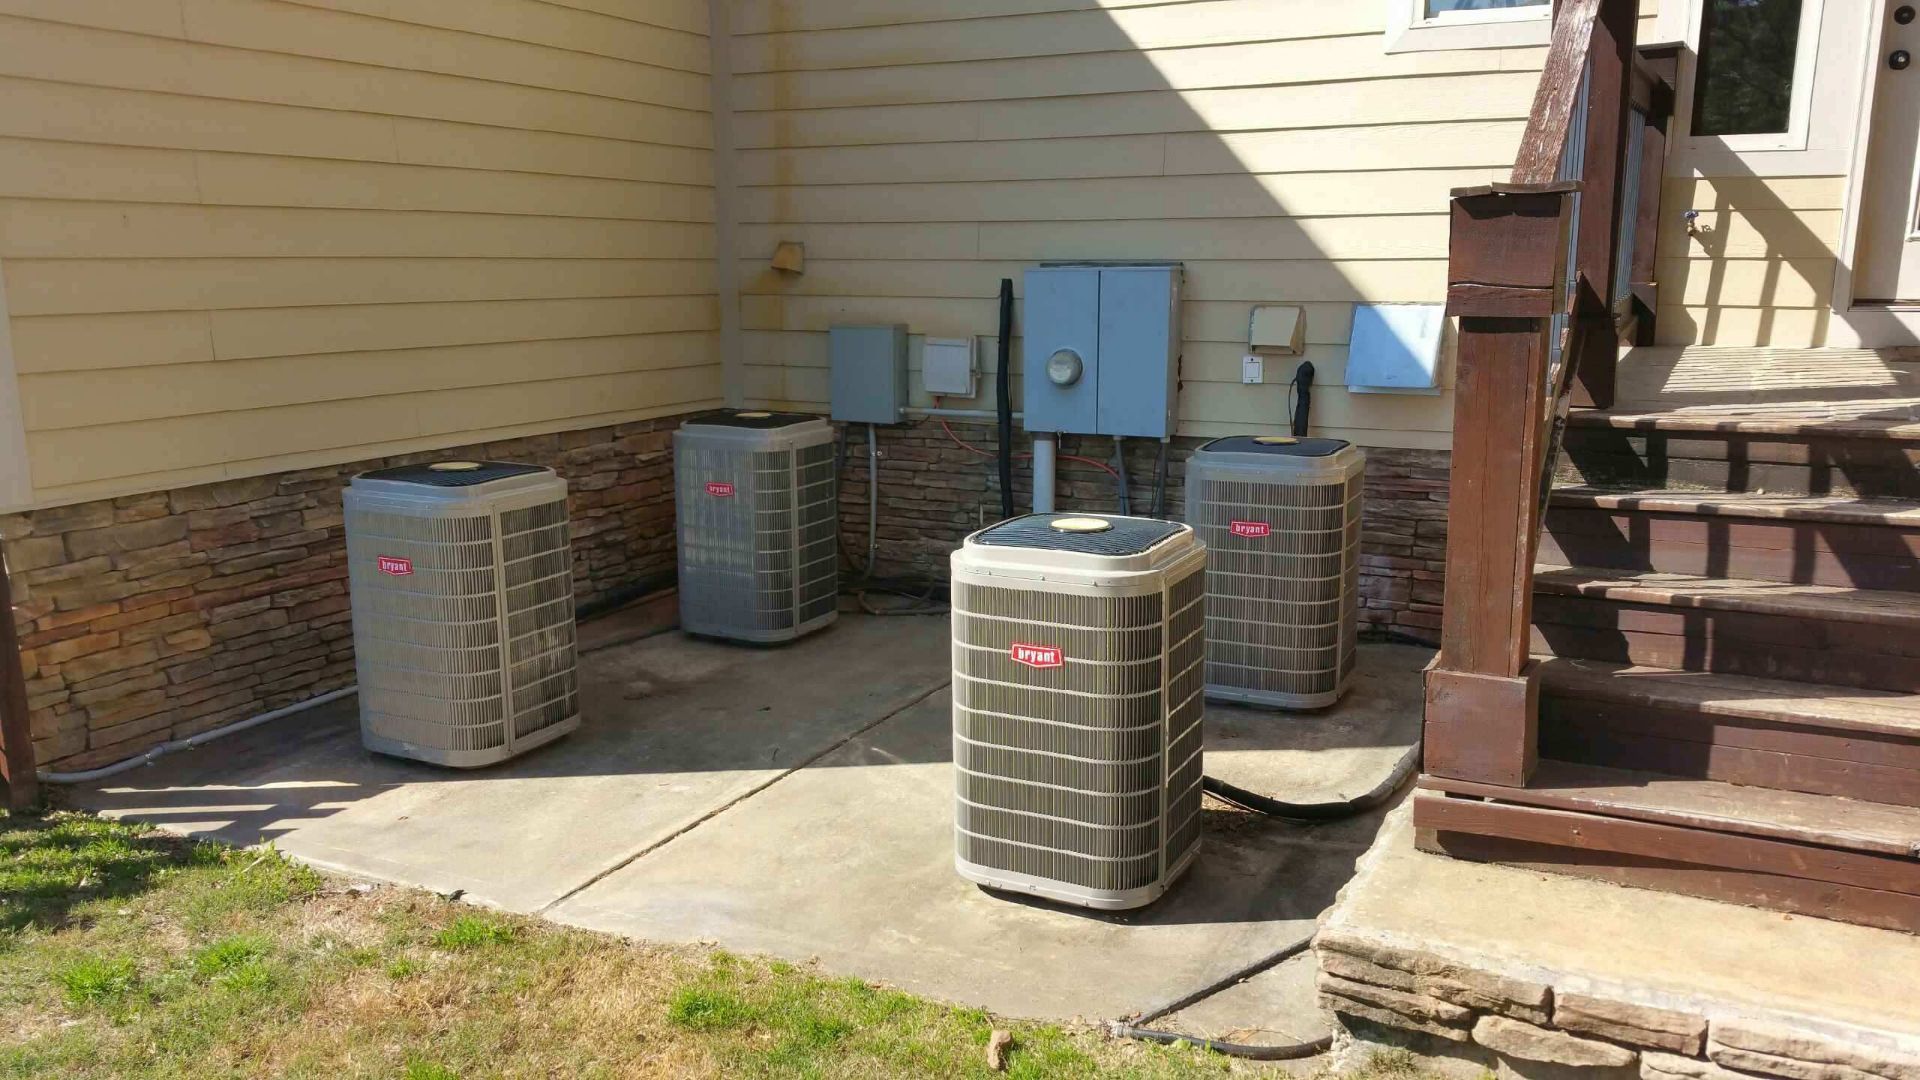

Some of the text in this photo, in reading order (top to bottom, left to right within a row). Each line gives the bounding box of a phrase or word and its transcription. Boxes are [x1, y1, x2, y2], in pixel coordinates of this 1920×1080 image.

[1235, 524, 1264, 534] bryant
[382, 560, 407, 572] bryant
[1018, 647, 1055, 663] bryant
